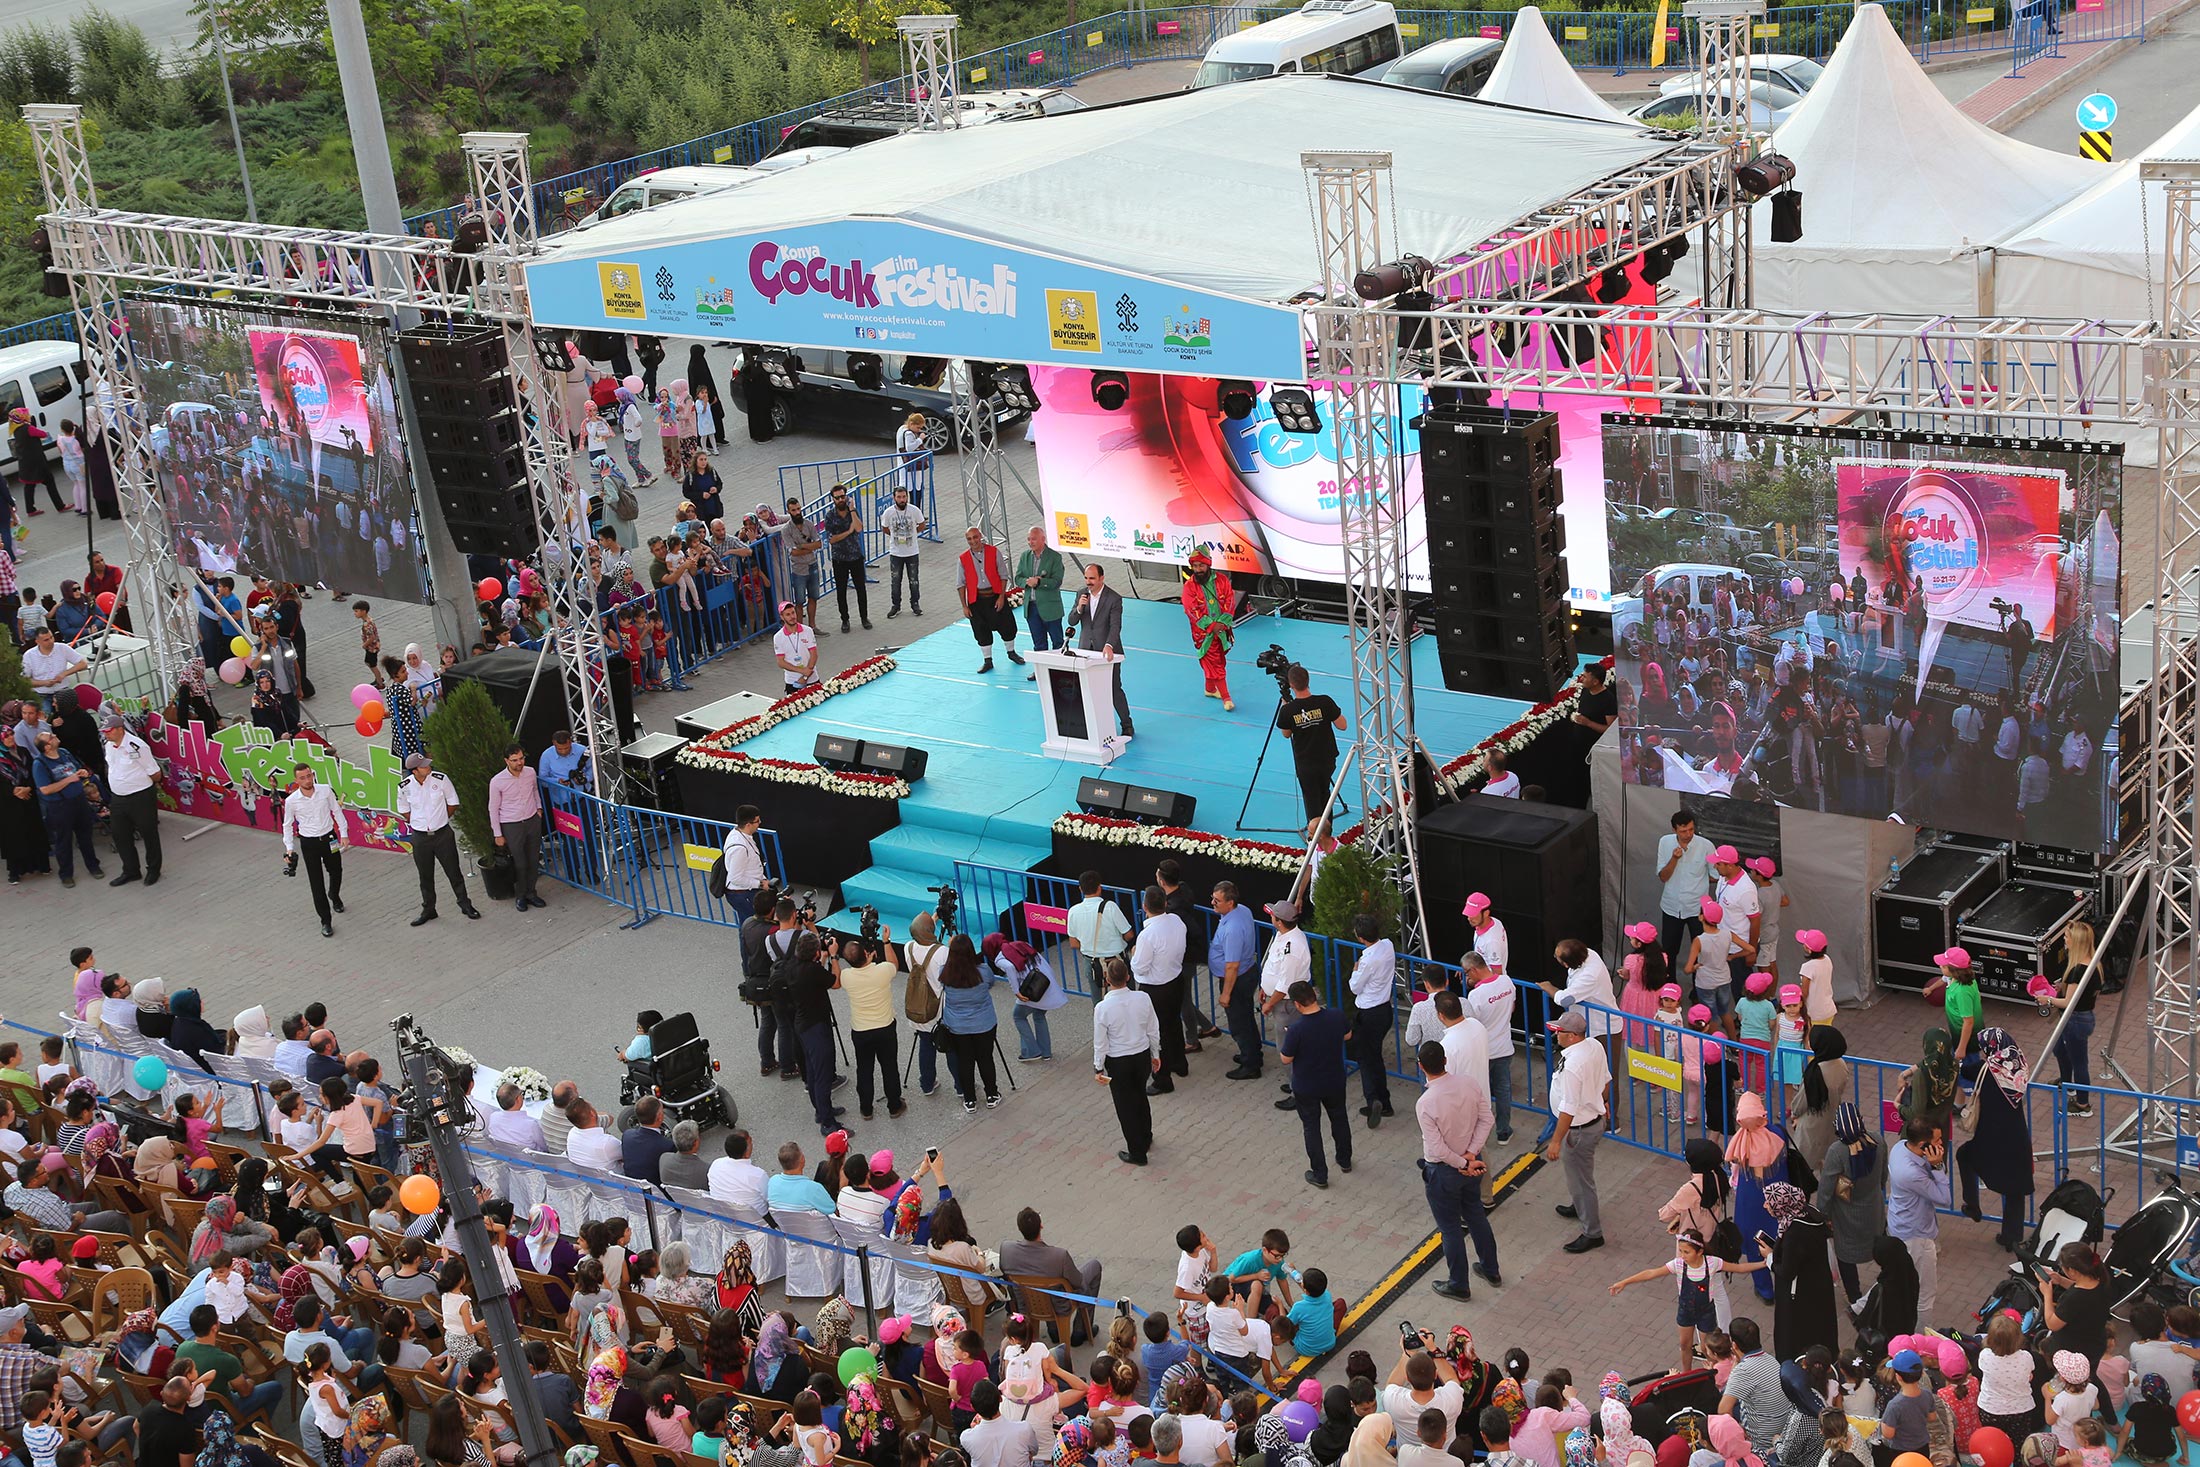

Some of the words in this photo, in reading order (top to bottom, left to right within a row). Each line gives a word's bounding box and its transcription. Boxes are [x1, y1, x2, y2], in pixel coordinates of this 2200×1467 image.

[780, 244, 820, 260] Konya
[1662, 248, 1668, 256] 5
[749, 241, 880, 309] Çocuk
[871, 257, 1017, 318] Festivali
[614, 292, 632, 300] KONYA
[823, 311, 946, 327] www.konyacocukfestivali.com
[1063, 322, 1085, 331] KONYA
[1053, 329, 1097, 341] BÜYÜKŞEHİR
[1218, 380, 1428, 473] Festival
